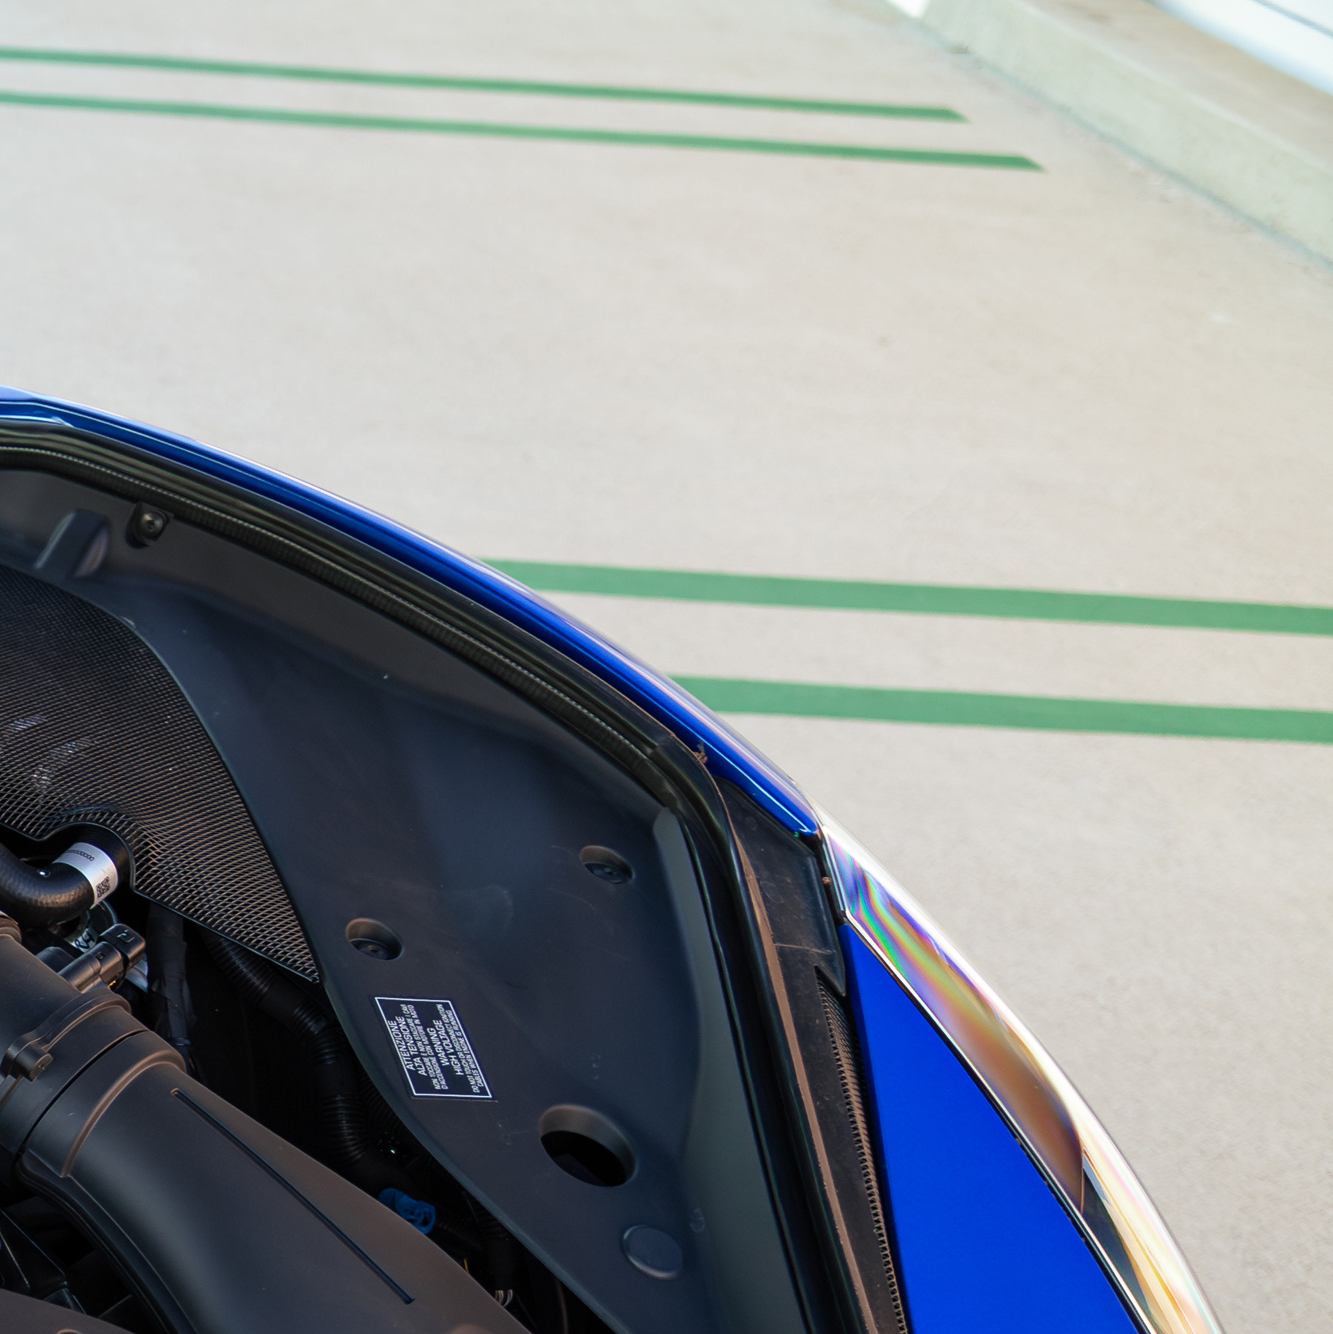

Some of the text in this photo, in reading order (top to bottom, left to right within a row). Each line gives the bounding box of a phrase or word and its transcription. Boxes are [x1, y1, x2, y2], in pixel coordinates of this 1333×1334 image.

[387, 1020, 415, 1069] ATTENZIONE
[395, 1016, 427, 1075] ALTA TENSIONE
[426, 1027, 450, 1065] WARNING
[433, 1020, 464, 1074] HIGH VOLTAGE
